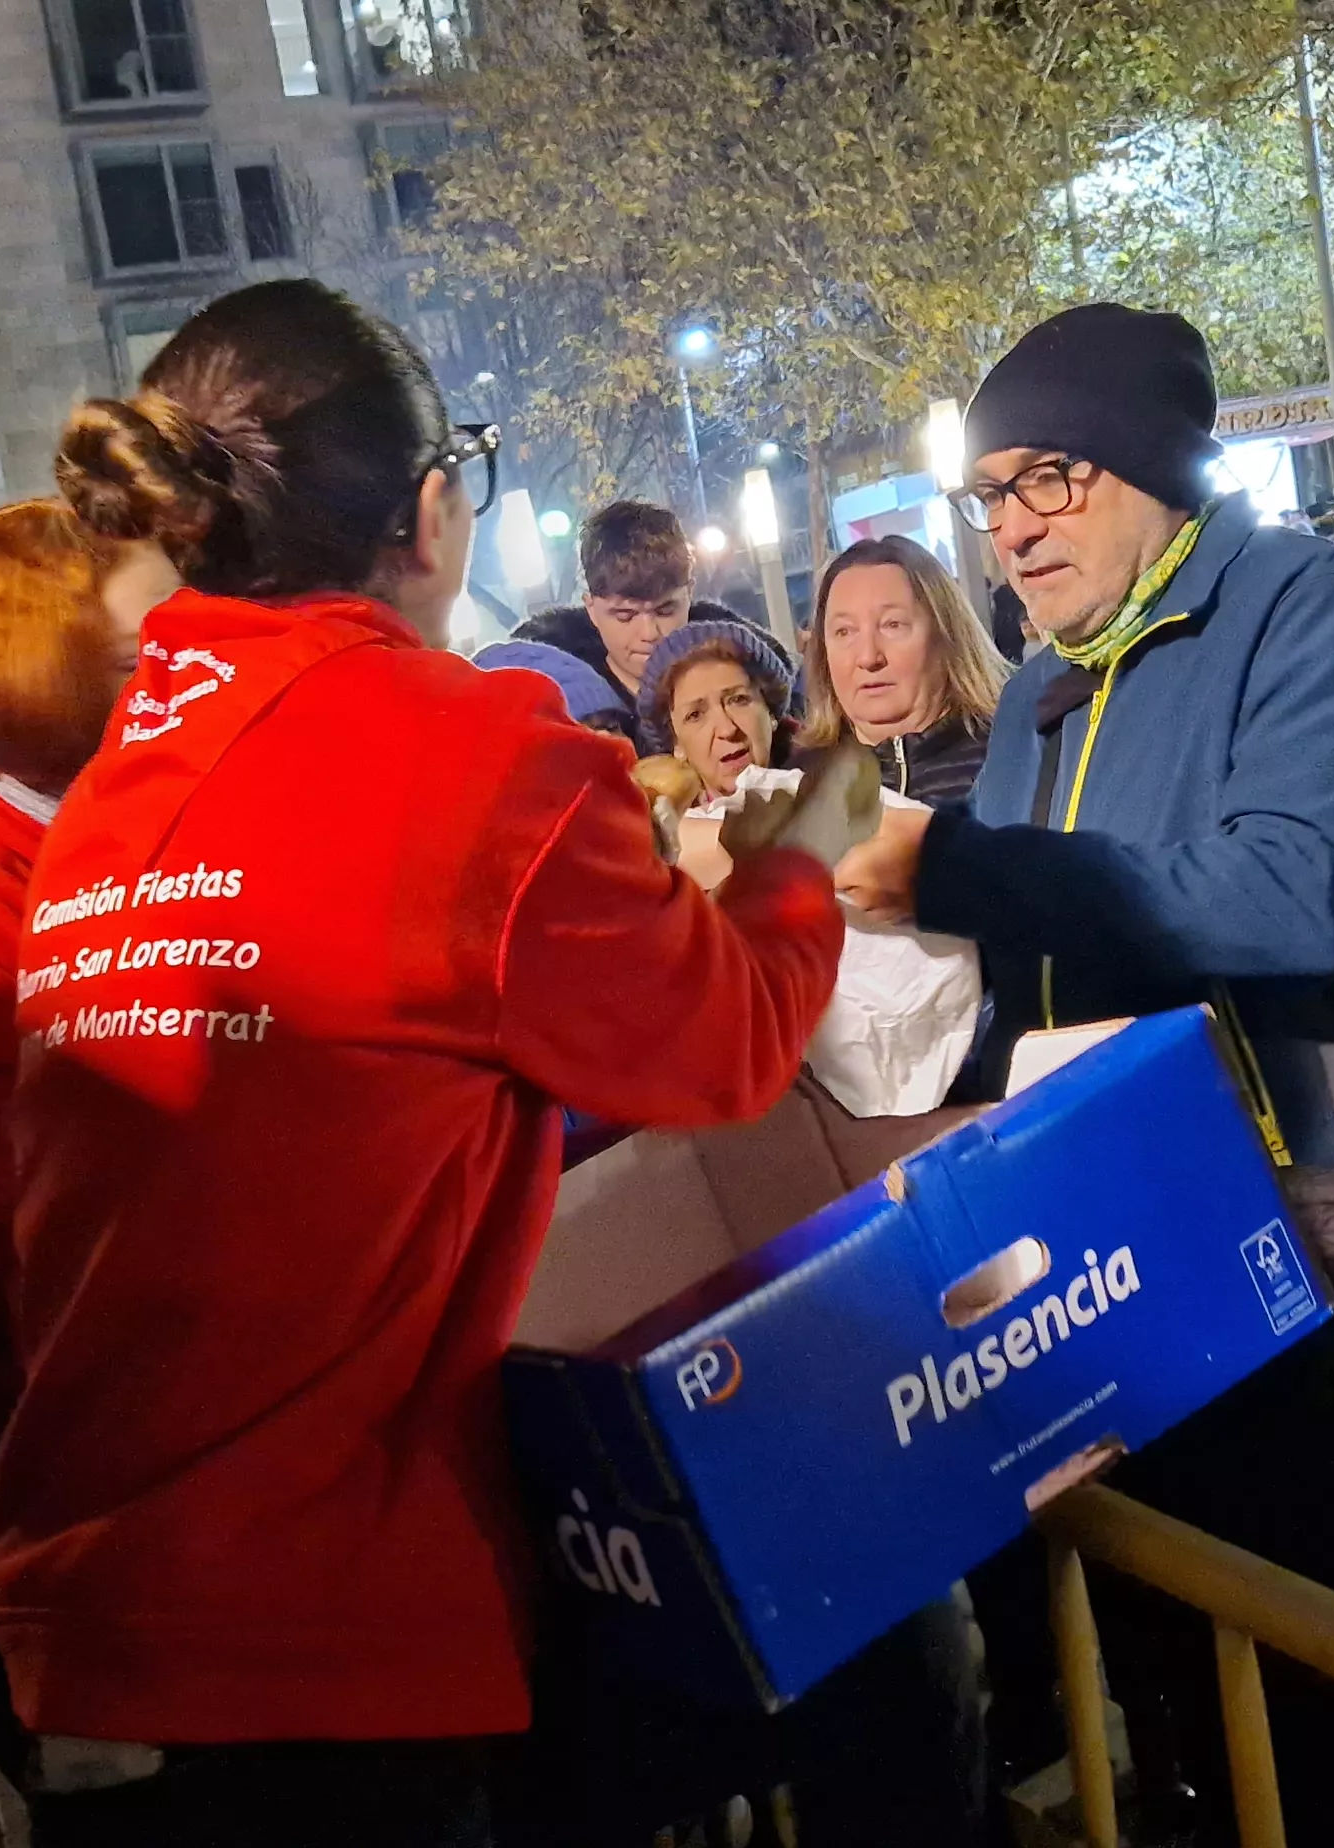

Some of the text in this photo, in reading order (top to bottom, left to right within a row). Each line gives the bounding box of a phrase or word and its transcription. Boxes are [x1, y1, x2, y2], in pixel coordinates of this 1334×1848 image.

[31, 862, 244, 934] Comisión Fiestas
[70, 946, 113, 982] San
[117, 936, 261, 971] Lorenzo
[44, 1011, 69, 1049] de
[73, 998, 276, 1044] Montserrat
[885, 1245, 1141, 1448] Plasencia
[675, 1349, 721, 1412] FP
